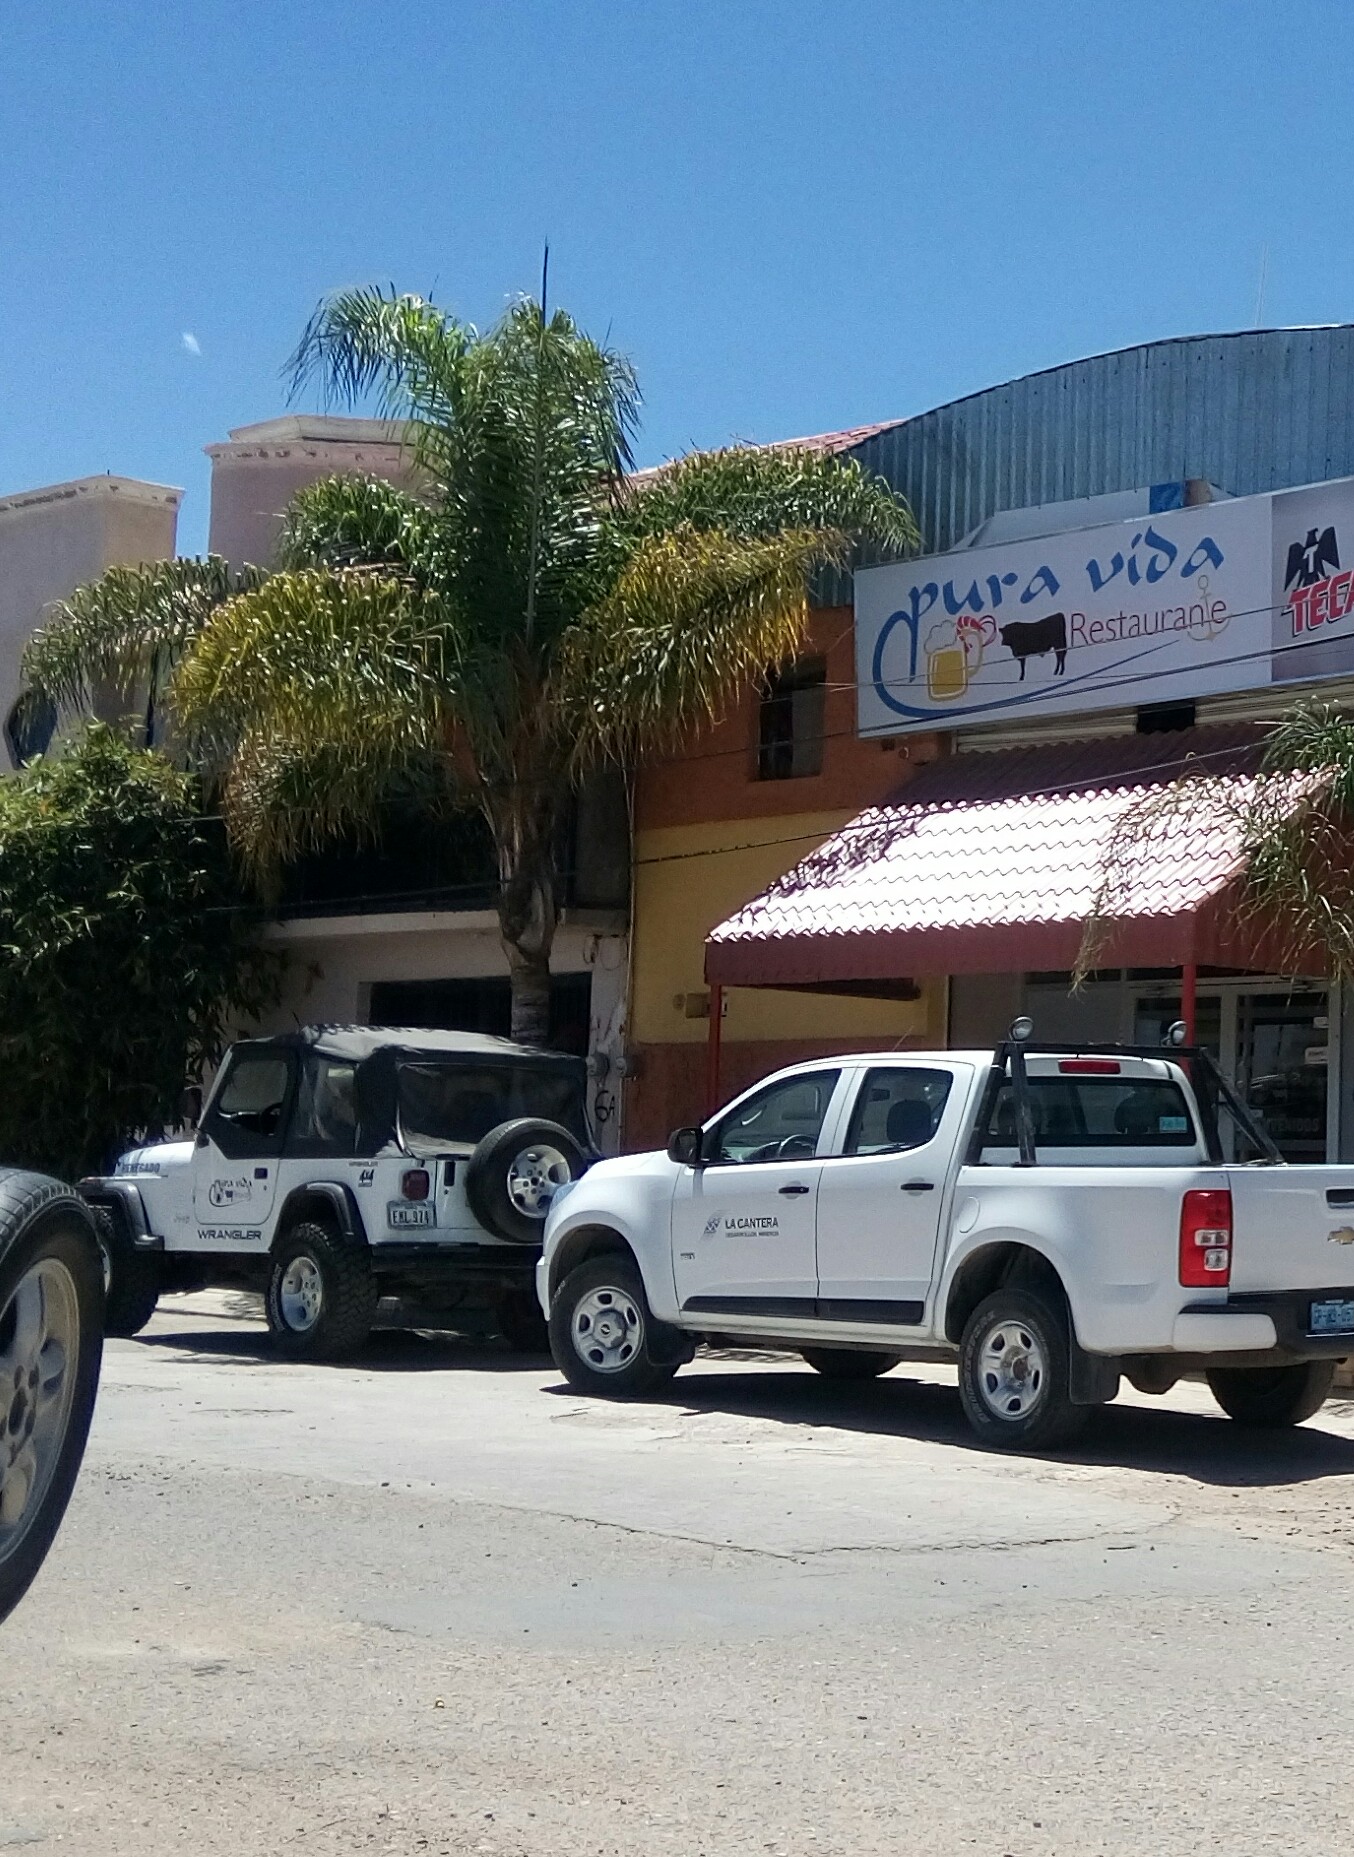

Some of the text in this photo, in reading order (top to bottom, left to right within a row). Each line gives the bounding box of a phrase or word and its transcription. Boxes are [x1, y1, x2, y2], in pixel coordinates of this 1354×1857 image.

[725, 1217, 779, 1229] LA CANTERA
[197, 1230, 262, 1240] WRANGLER
